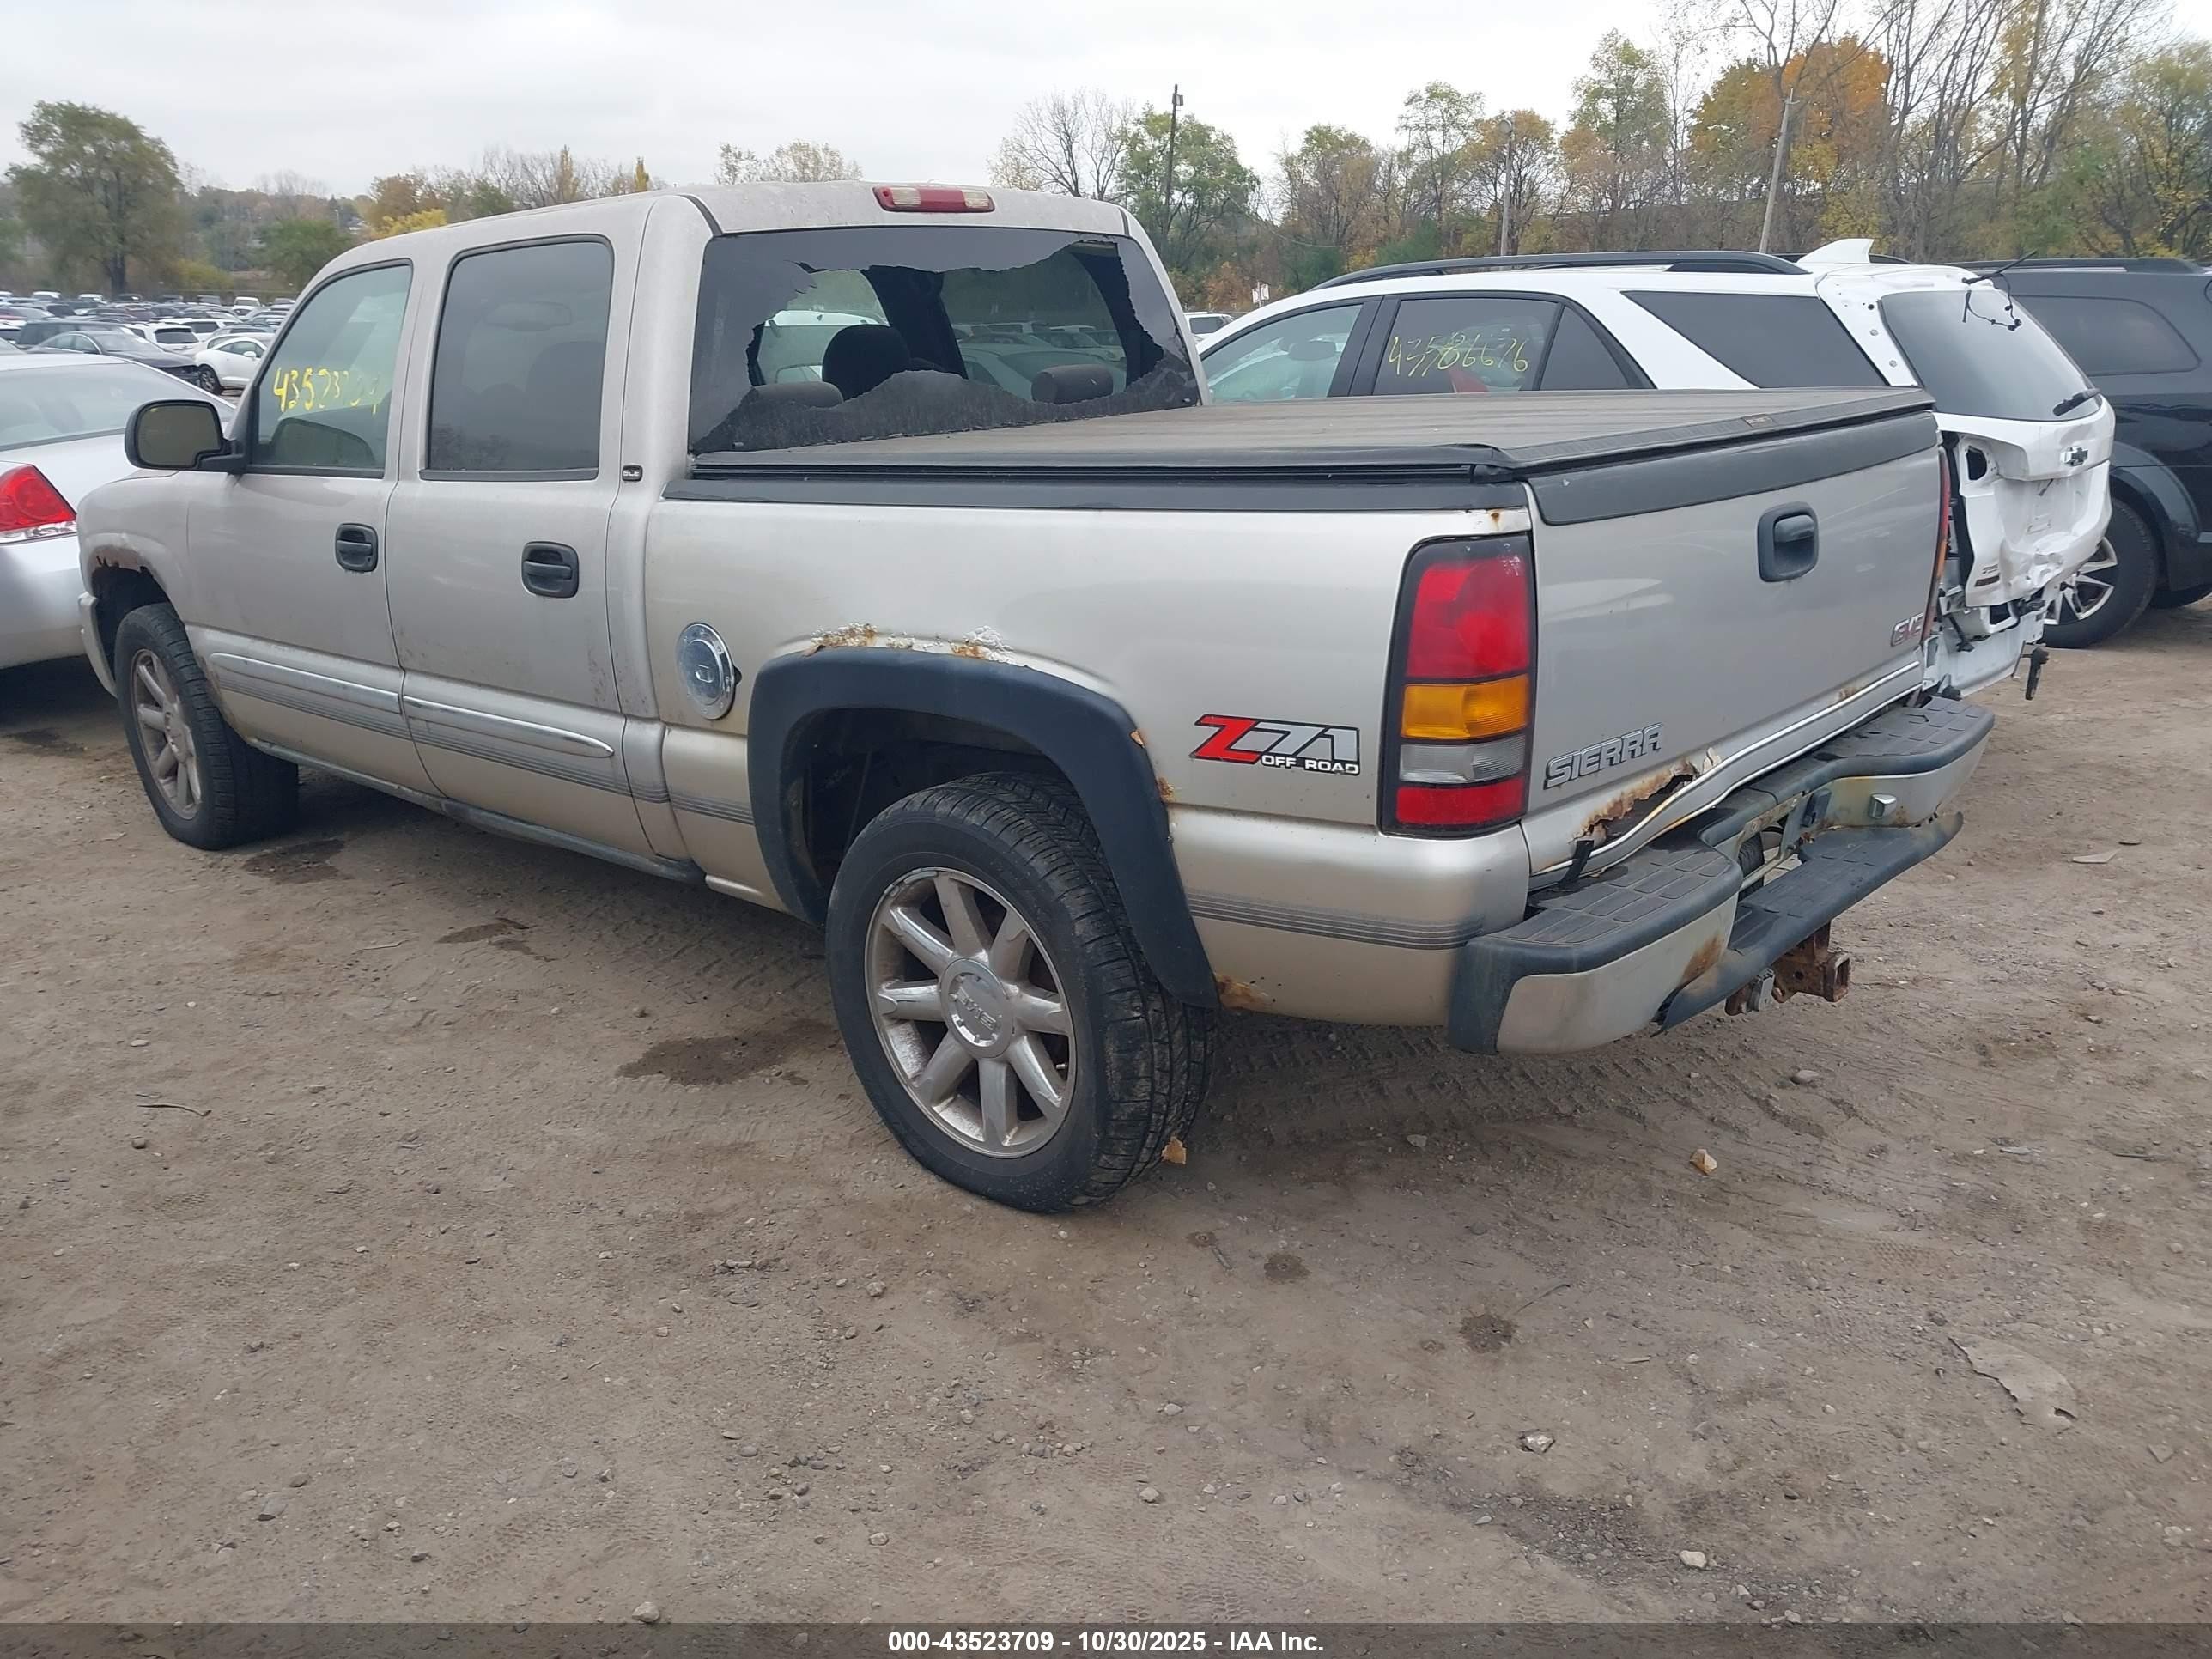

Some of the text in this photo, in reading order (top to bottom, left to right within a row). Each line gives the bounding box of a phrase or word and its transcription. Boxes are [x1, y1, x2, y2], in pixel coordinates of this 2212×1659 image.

[1189, 714, 1360, 765] Z71
[1261, 754, 1359, 775] OFF ROAD
[1544, 722, 1663, 790] SIERRA
